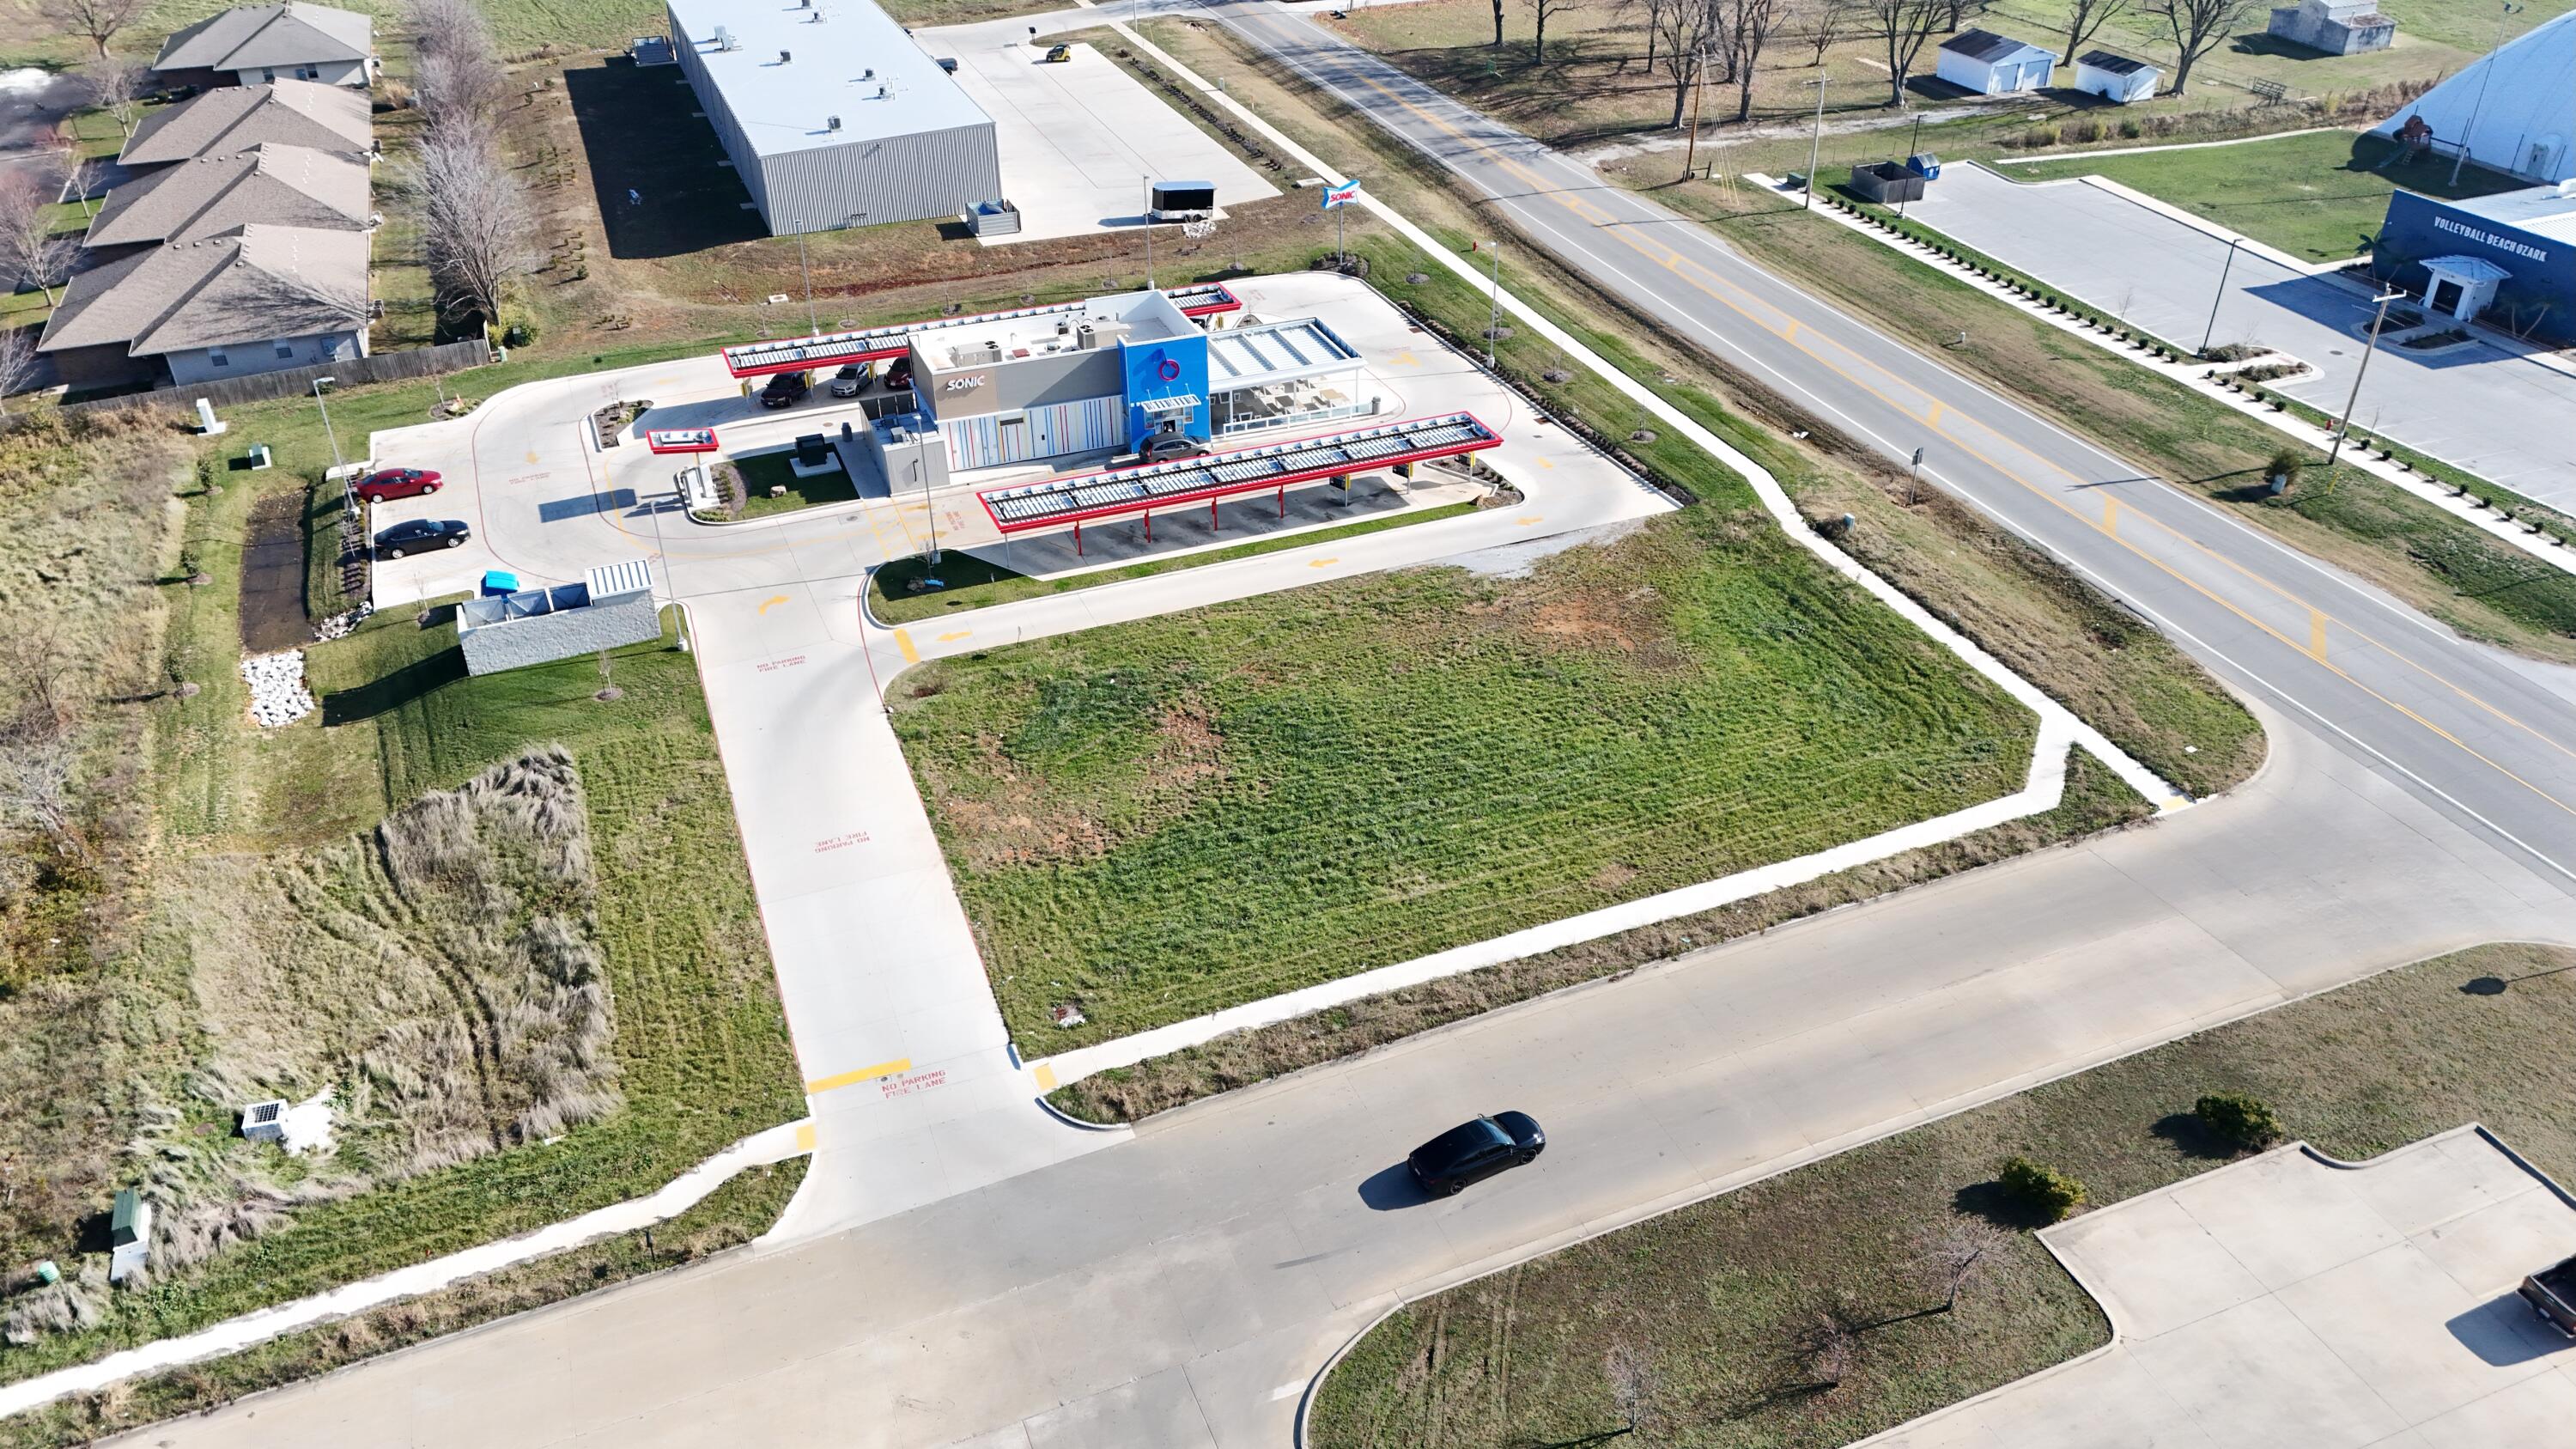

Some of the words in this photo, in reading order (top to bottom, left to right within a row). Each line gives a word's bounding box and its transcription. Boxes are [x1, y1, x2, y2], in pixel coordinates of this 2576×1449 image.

[1330, 190, 1356, 202] SONIC
[2433, 216, 2486, 243] VOLLEYBALL
[2486, 234, 2518, 253] BEACH
[2516, 243, 2549, 263] OZARK
[946, 374, 985, 391] SONIC
[772, 654, 805, 666] PARKING
[882, 1082, 897, 1093] NO
[902, 1069, 946, 1087] PARKING
[885, 1087, 911, 1099] FIRE
[916, 1077, 947, 1093] LANE
